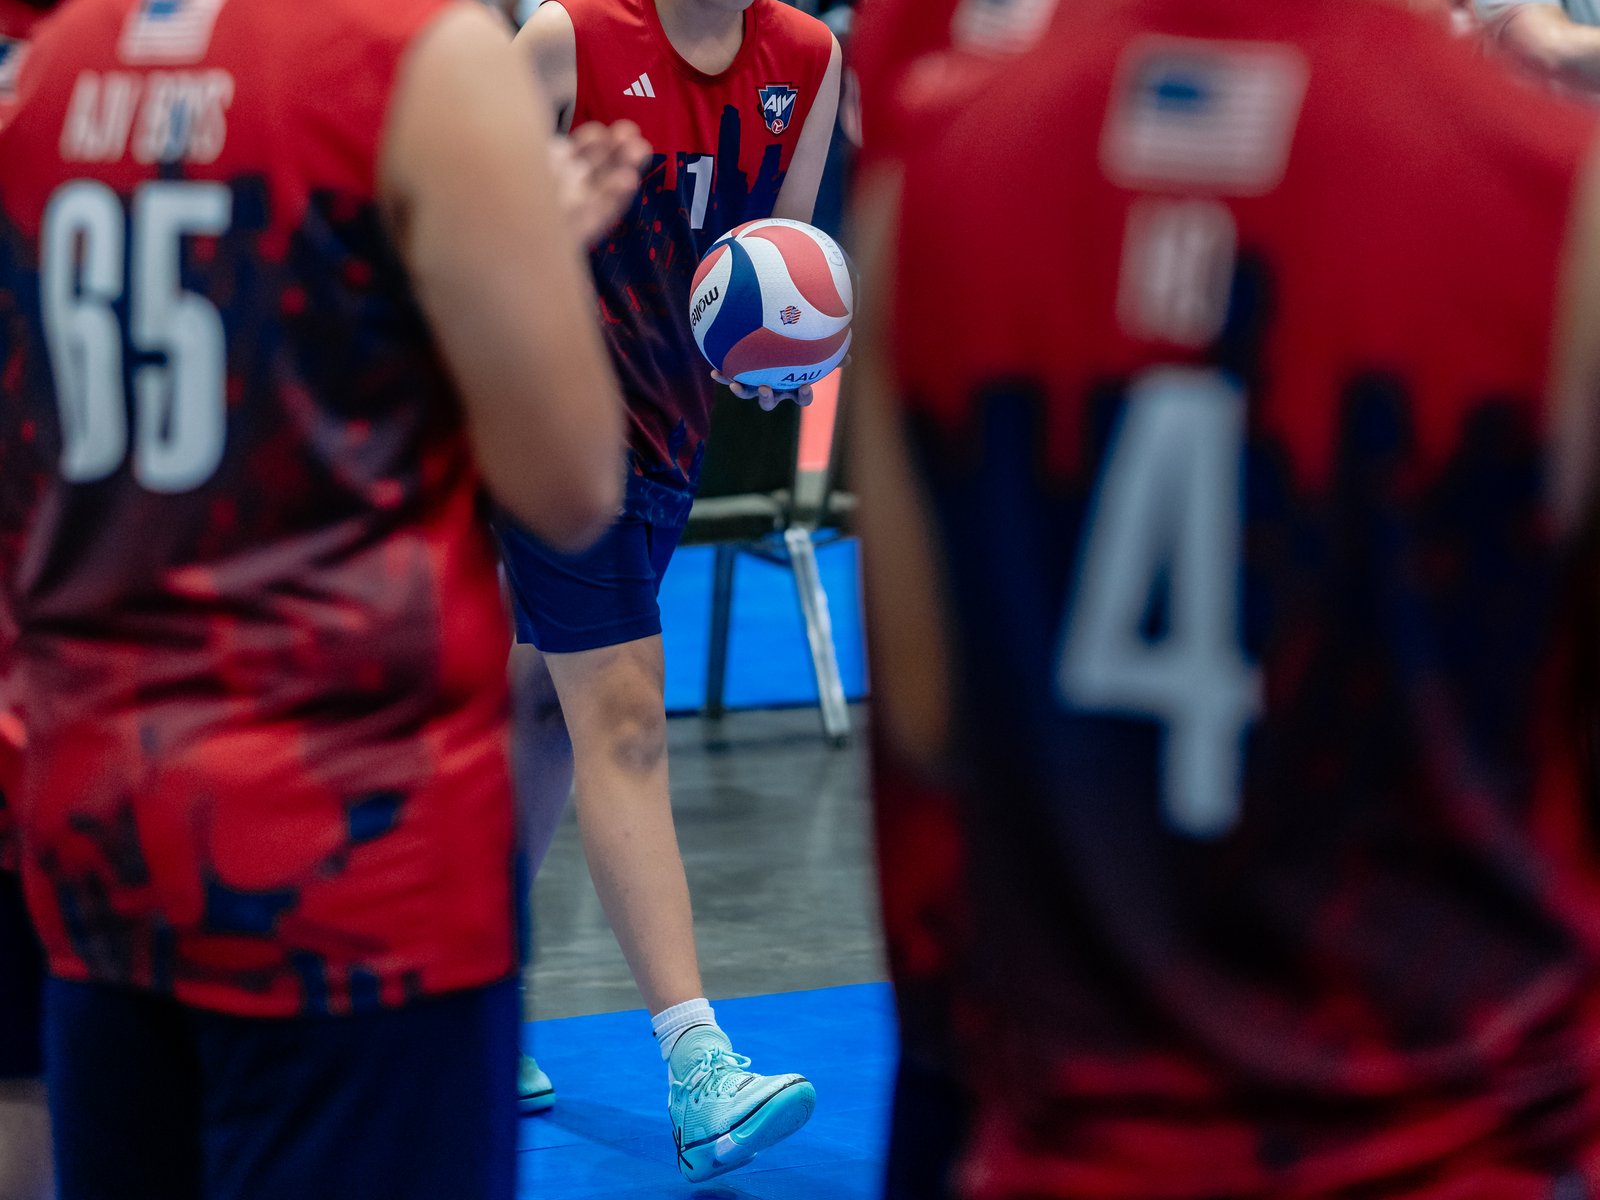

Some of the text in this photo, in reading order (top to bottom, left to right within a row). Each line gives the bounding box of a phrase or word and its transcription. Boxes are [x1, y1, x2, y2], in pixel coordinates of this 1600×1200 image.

[764, 93, 797, 117] AJV
[687, 155, 713, 230] 1
[40, 180, 232, 492] 65
[691, 286, 719, 331] molte
[781, 369, 822, 382] AAU
[1056, 366, 1264, 836] 4
